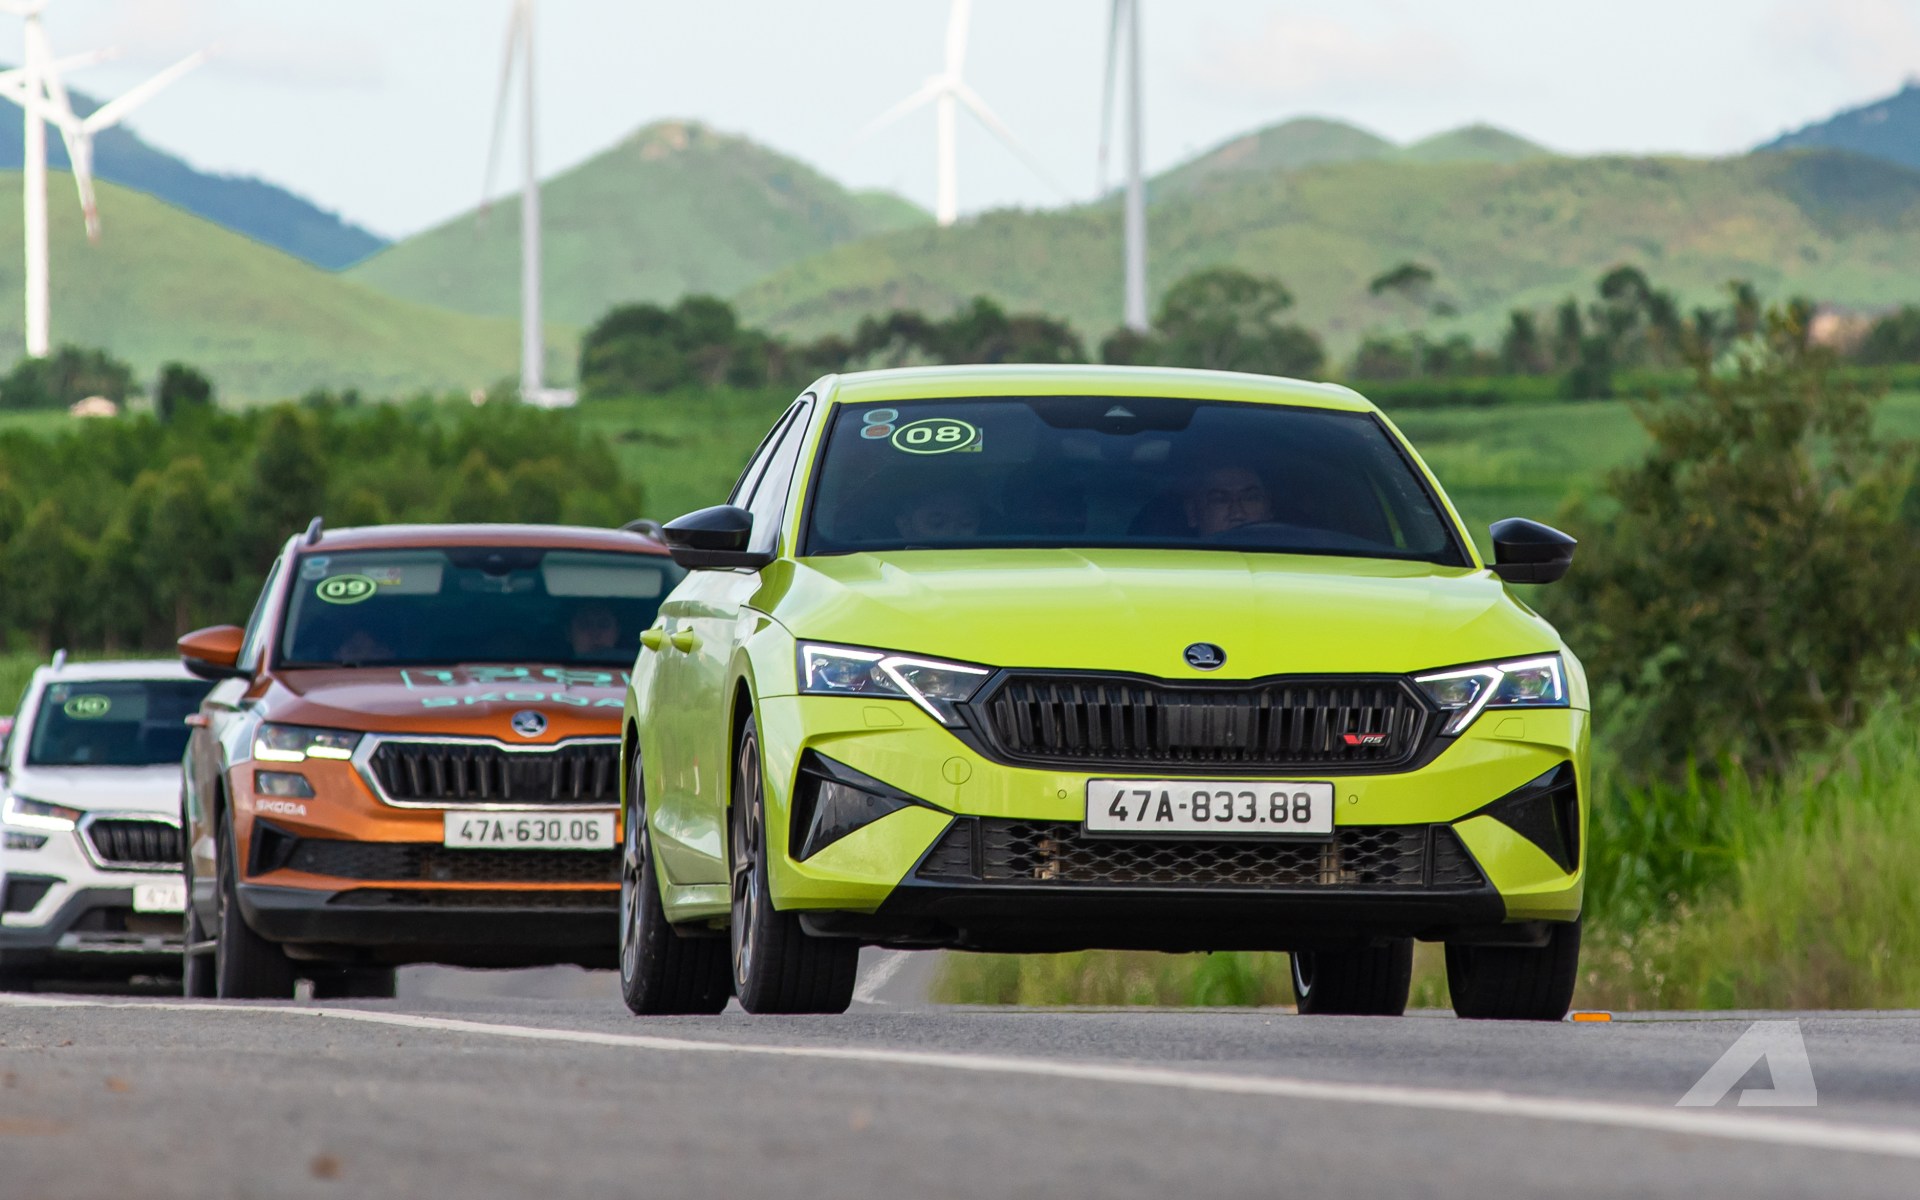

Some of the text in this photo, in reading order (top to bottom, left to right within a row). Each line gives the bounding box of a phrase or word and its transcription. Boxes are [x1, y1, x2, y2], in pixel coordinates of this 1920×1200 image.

[906, 426, 961, 444] 08
[326, 581, 367, 596] 09
[1108, 790, 1312, 824] 47A-833.88
[461, 819, 599, 842] 47A-630.06
